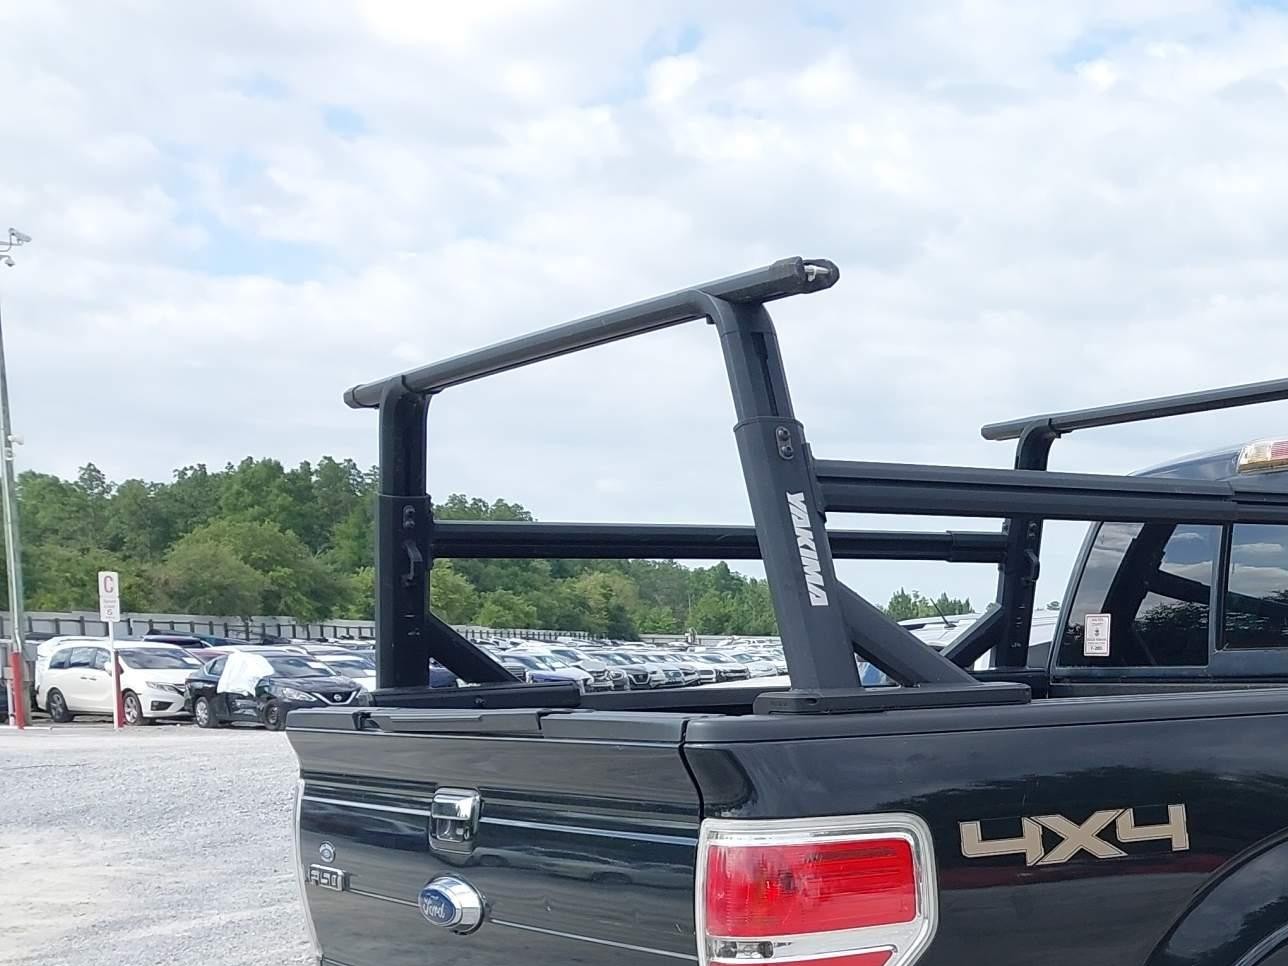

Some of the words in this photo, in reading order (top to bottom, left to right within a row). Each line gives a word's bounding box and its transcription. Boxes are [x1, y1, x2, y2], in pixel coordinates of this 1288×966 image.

[786, 491, 829, 606] YAKIMA
[103, 575, 114, 593] C
[422, 892, 447, 919] Ford
